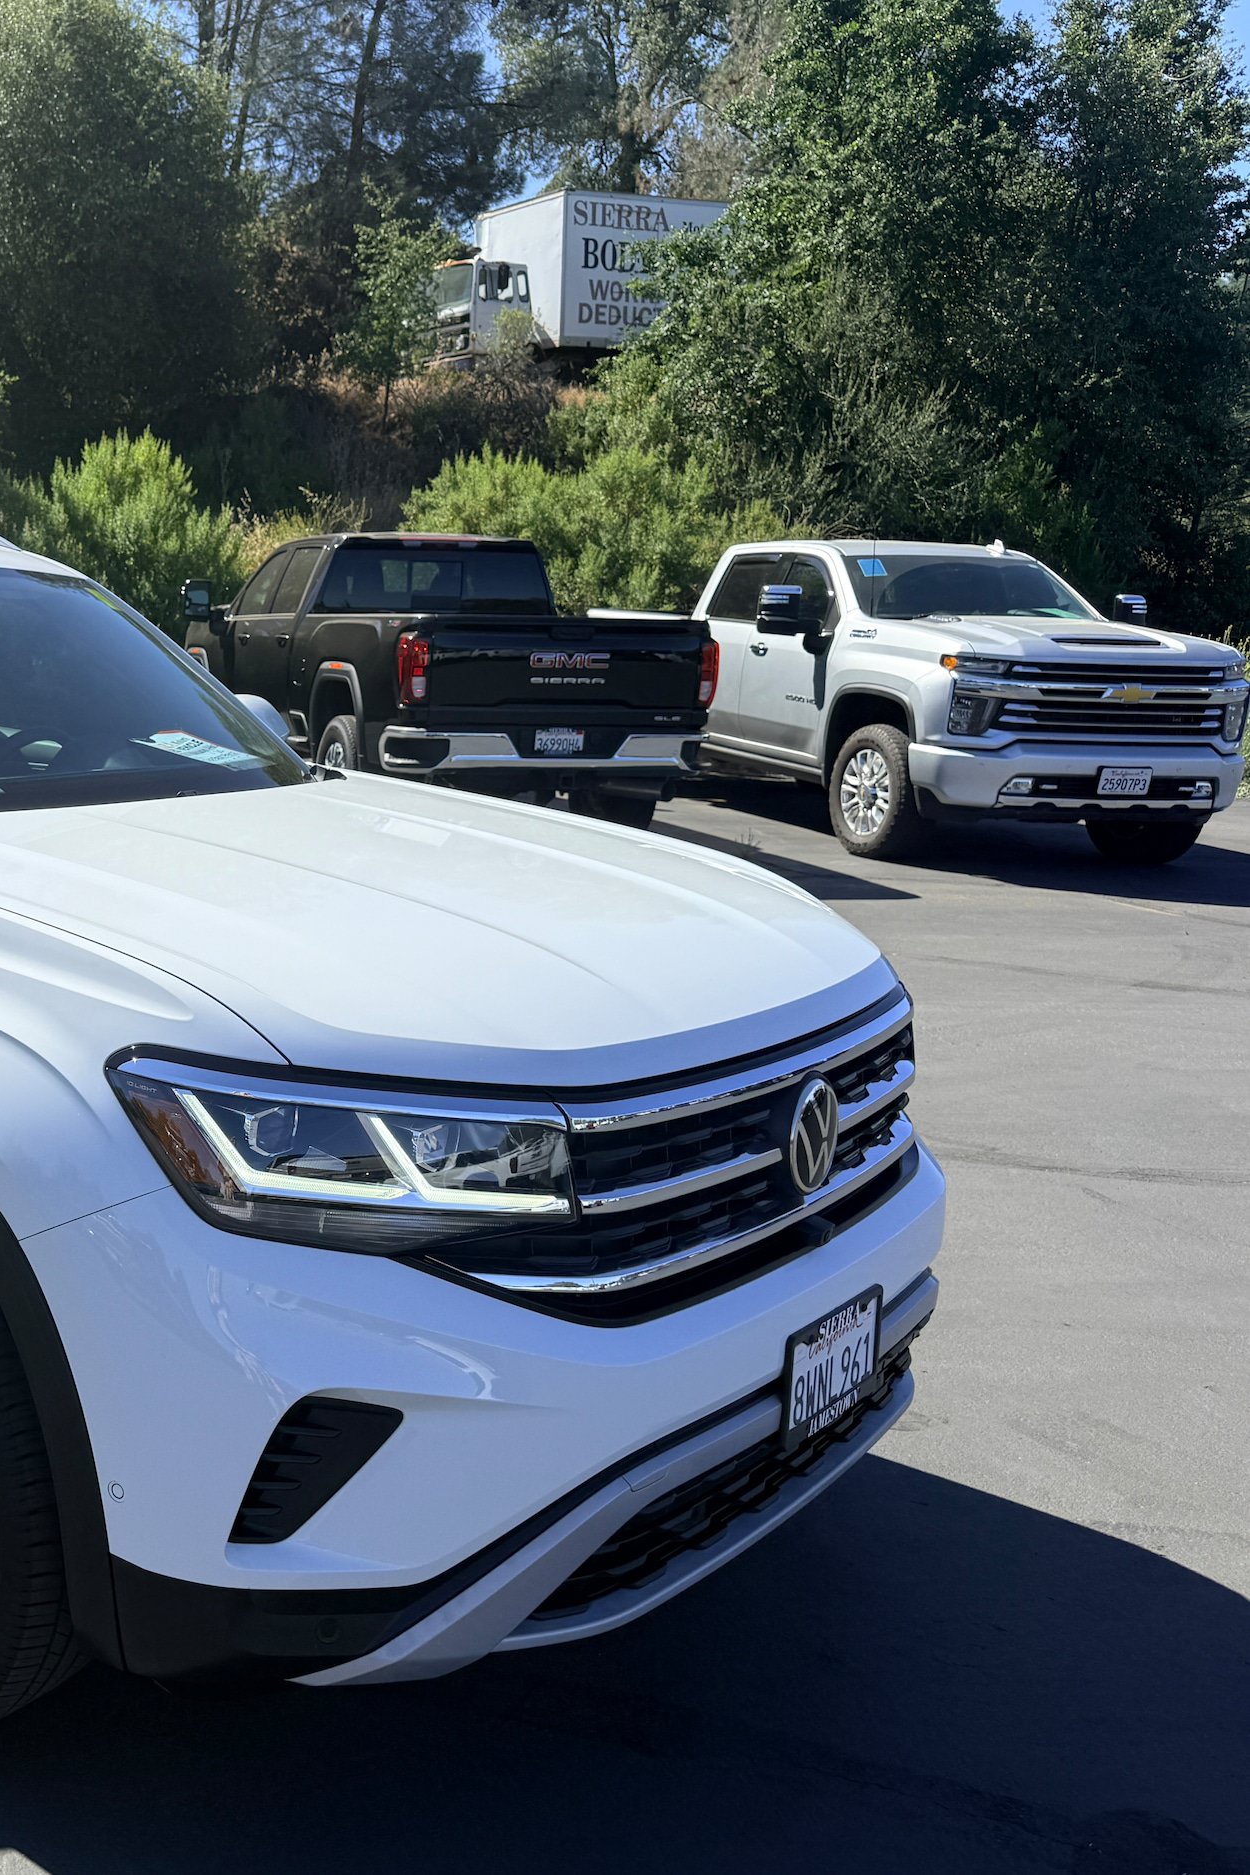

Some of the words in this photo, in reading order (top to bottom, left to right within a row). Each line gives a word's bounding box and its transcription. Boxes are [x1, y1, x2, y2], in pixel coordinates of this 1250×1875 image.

[573, 200, 670, 232] SIERRA
[529, 651, 612, 669] GMC
[529, 676, 606, 685] SIERRA
[1101, 778, 1147, 791] 25907P3
[818, 1300, 861, 1341] SIERRA
[807, 1386, 861, 1439] JAMESTOWN
